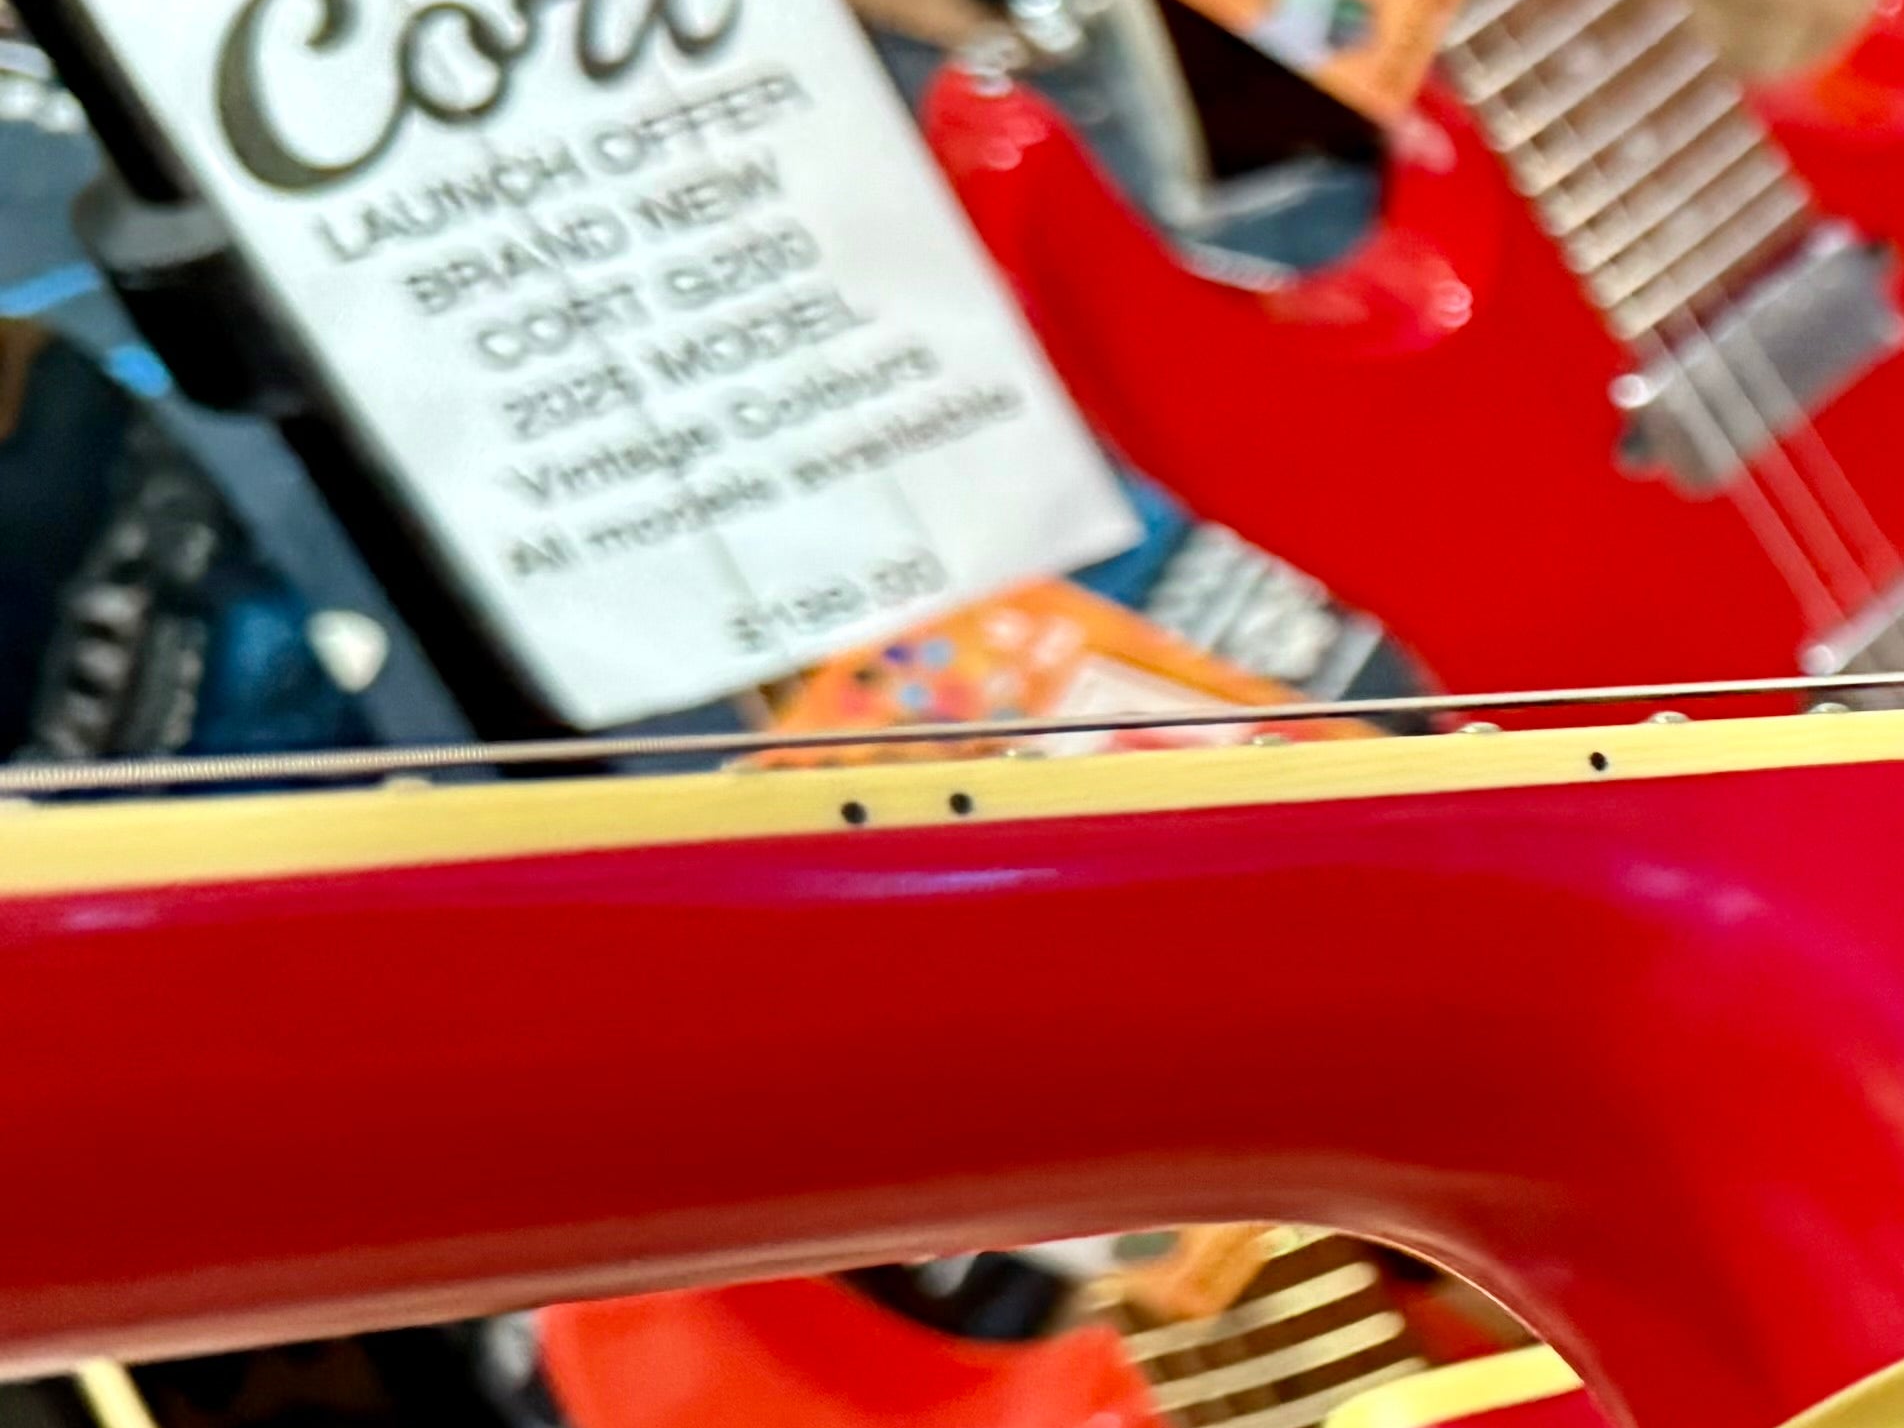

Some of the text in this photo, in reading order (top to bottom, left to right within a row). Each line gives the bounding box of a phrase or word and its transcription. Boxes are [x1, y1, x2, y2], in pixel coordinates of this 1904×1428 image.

[314, 70, 815, 263] LAUNCH OFFER
[405, 154, 791, 316] BRAND NEW
[475, 278, 658, 372] CORT
[646, 286, 878, 392] MODEL
[506, 384, 1030, 579] All models available
[510, 338, 945, 504] Vintage Colours
